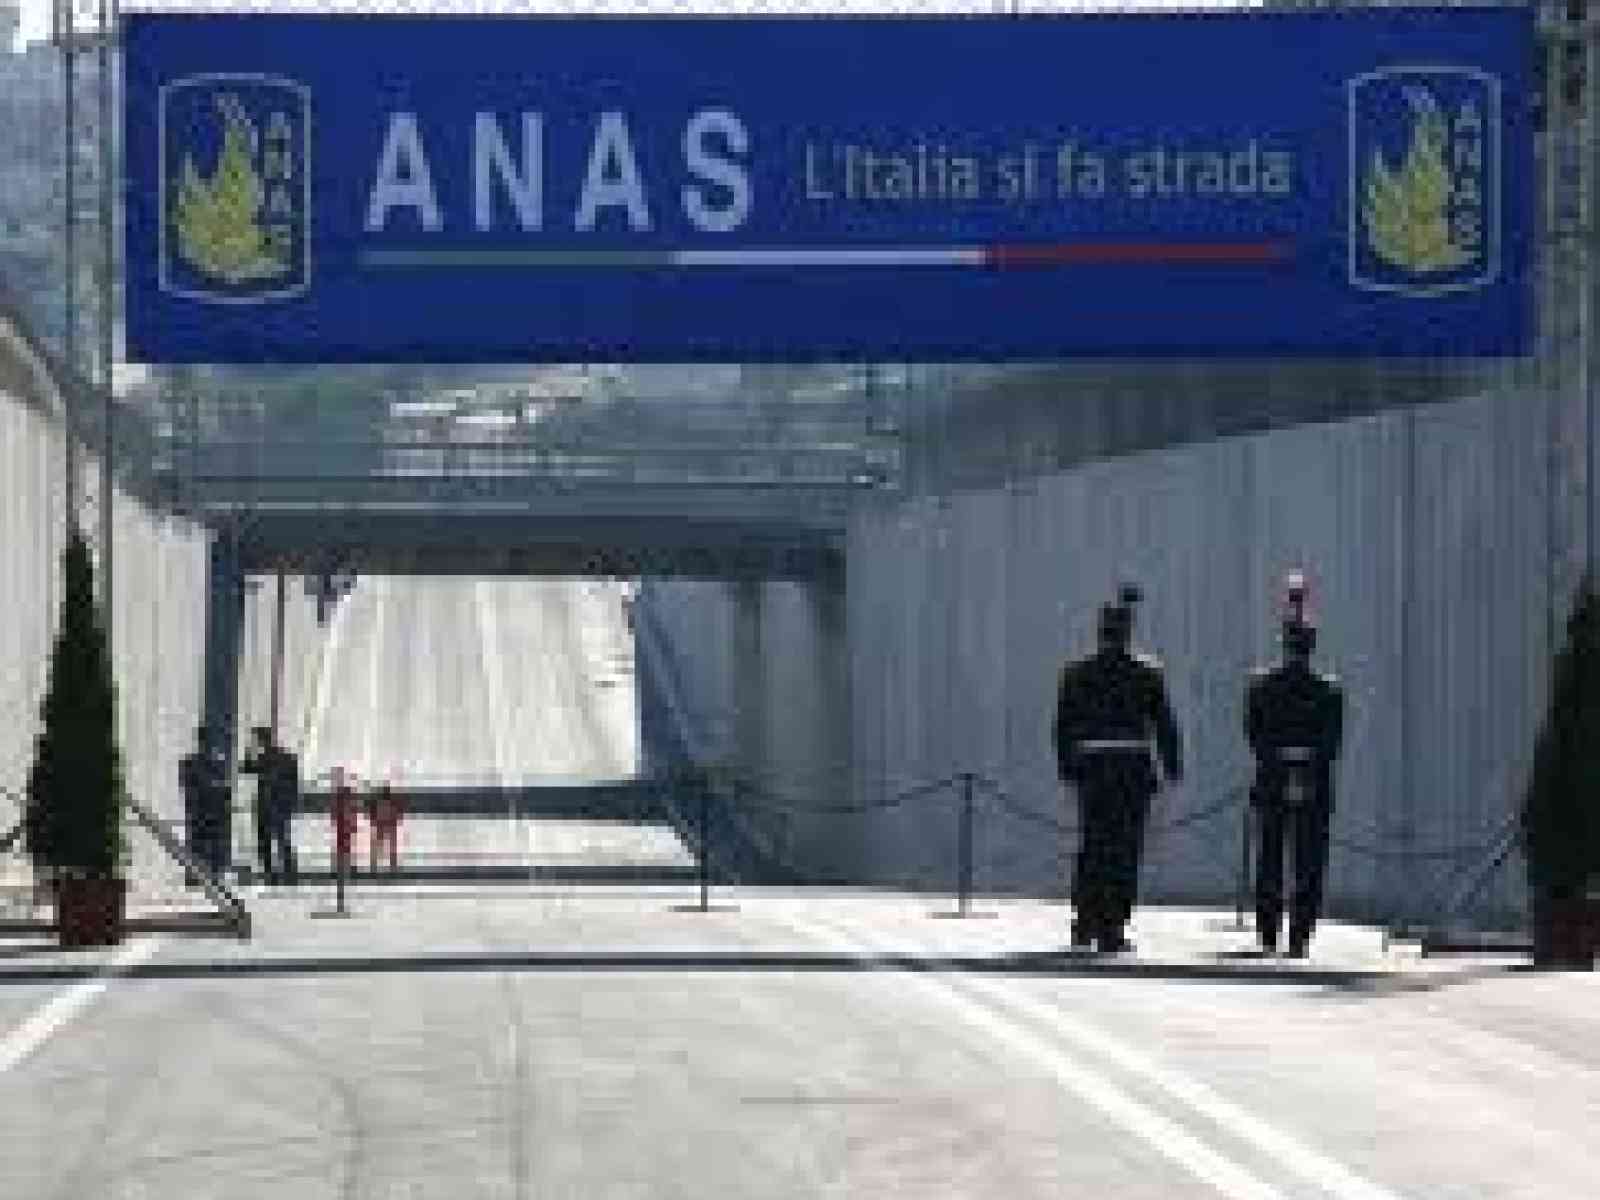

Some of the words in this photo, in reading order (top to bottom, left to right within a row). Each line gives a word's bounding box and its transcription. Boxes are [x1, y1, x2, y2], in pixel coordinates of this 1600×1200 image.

[363, 106, 755, 232] ANAS
[805, 143, 980, 200] L'Italia
[997, 140, 1040, 200] si
[1056, 138, 1105, 199] fa
[1123, 138, 1294, 198] strada
